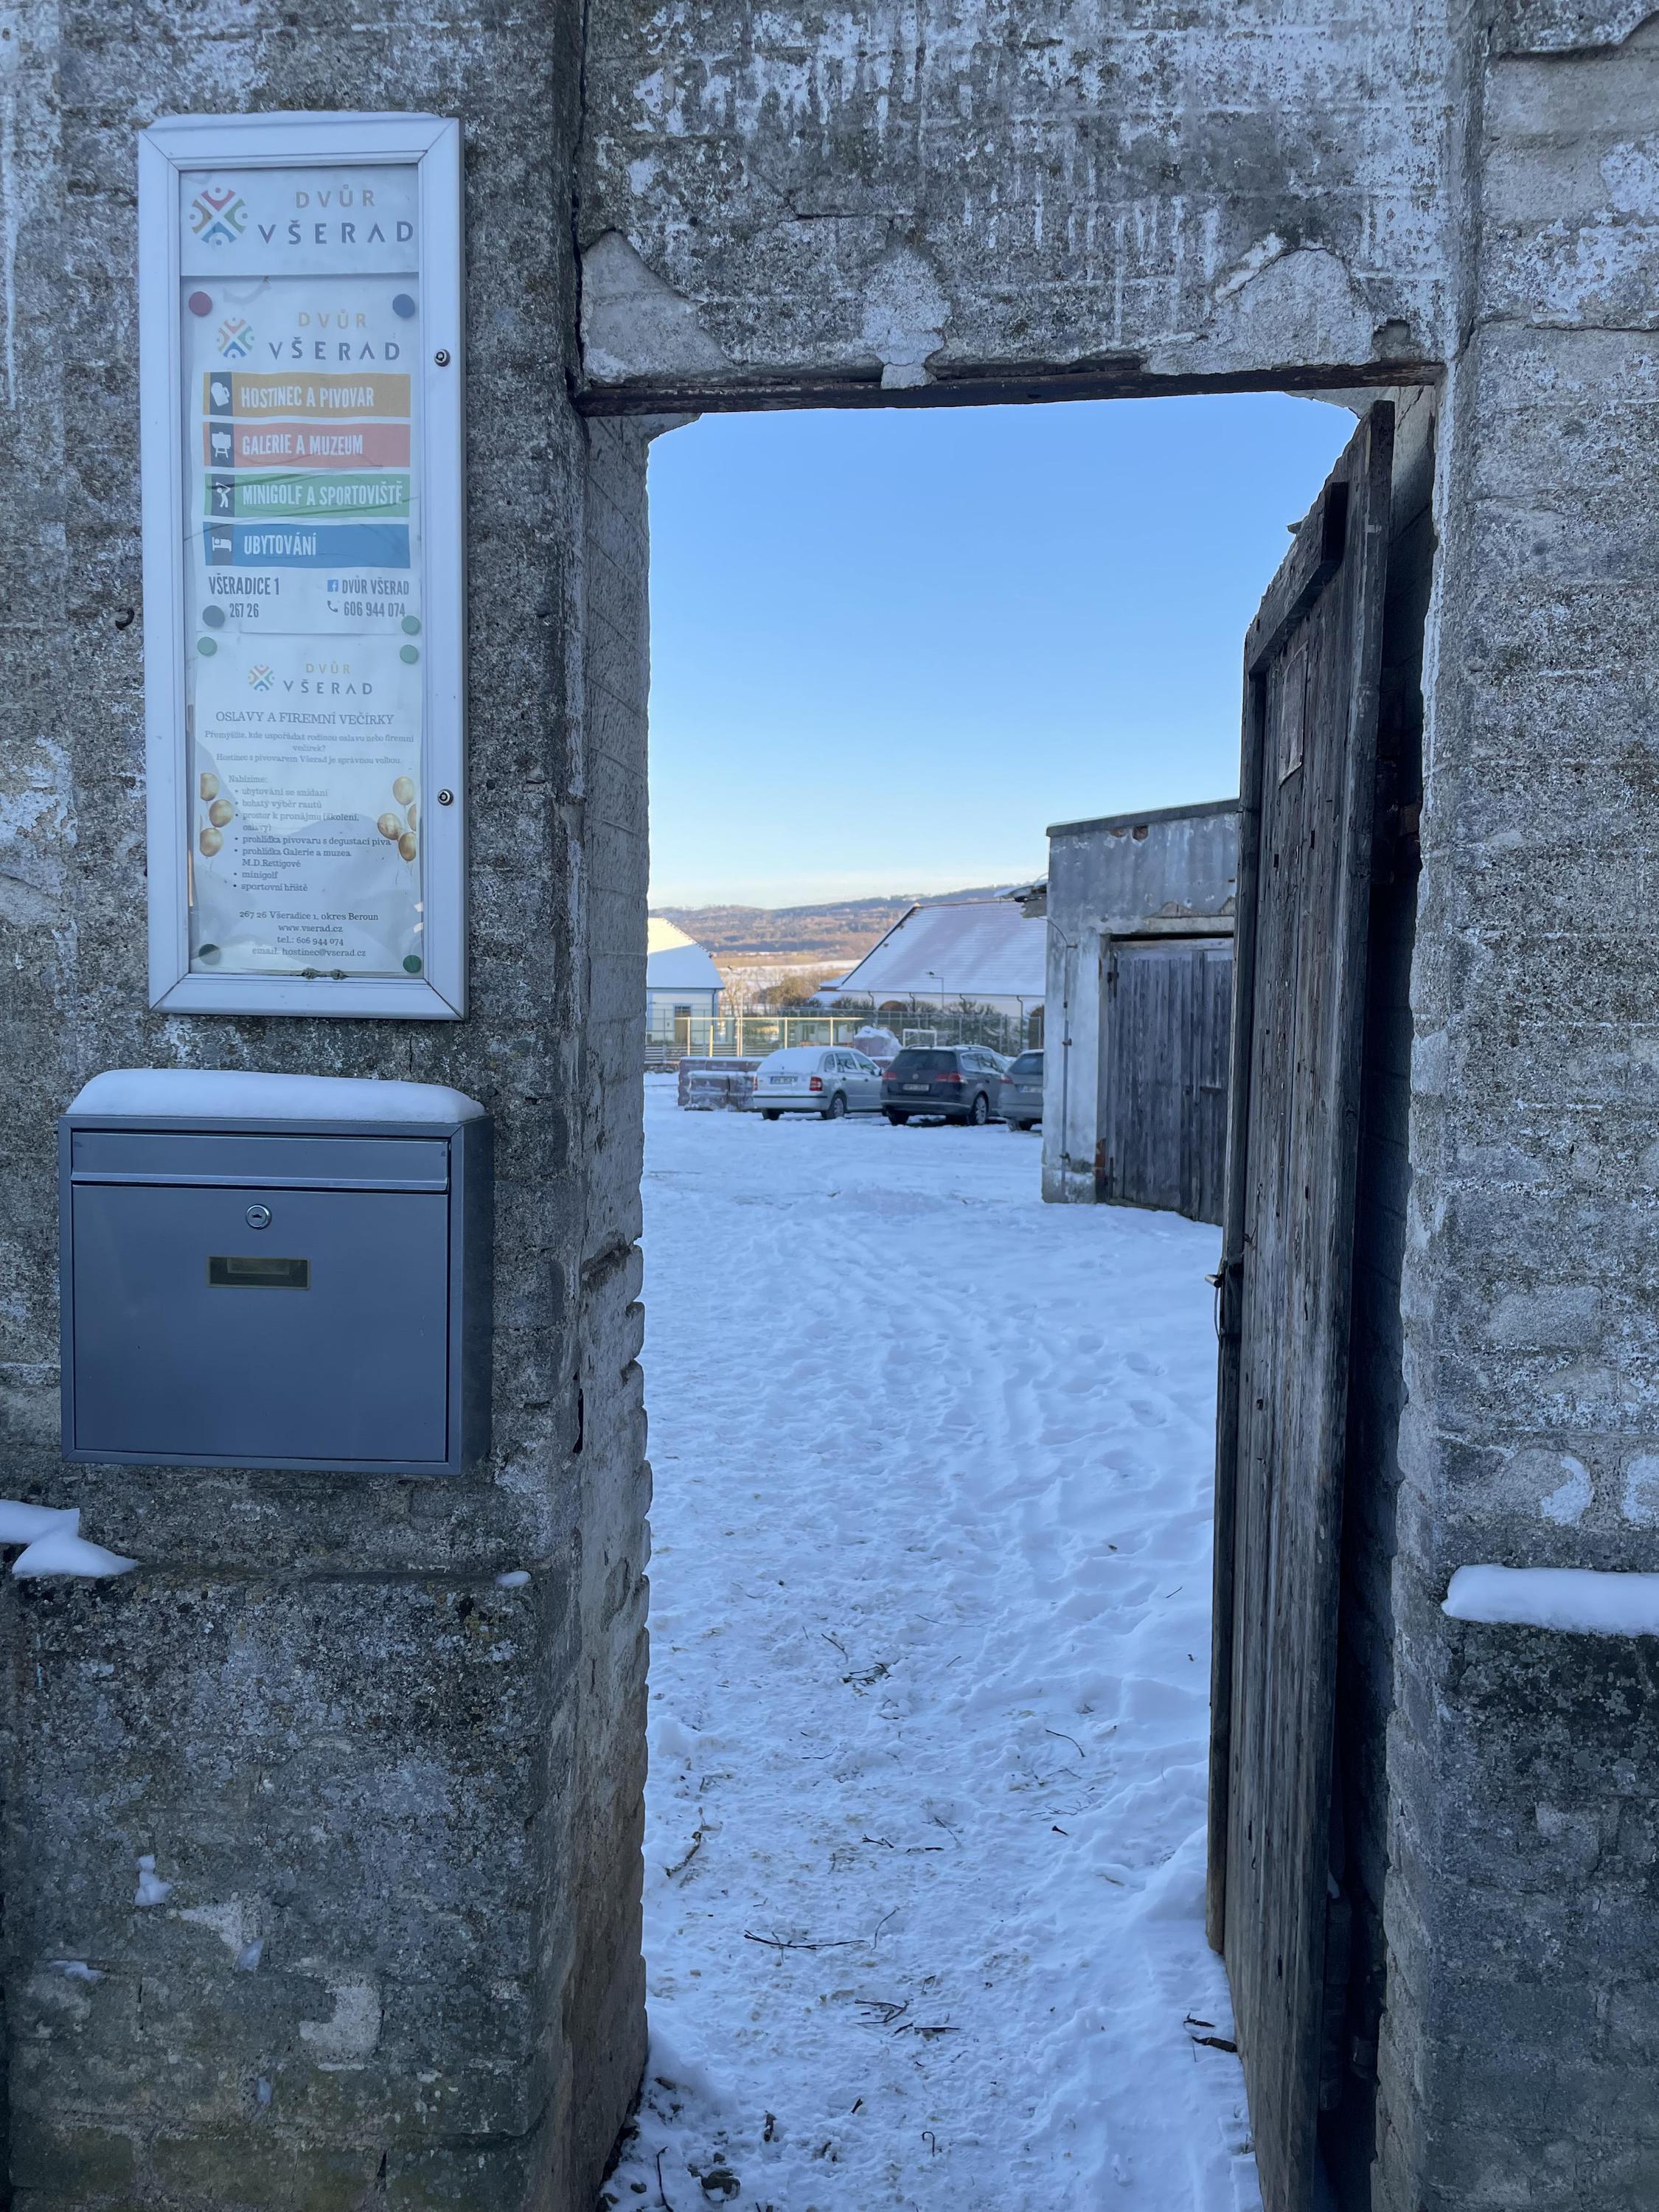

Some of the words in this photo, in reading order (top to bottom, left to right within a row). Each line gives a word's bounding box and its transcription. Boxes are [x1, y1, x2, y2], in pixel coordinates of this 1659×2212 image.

[296, 184, 375, 209] DVŮR
[258, 220, 414, 245] VŠERAD
[299, 309, 366, 329] DVŮR
[268, 337, 400, 361] VŠERAD
[241, 386, 302, 407] HOSTINEC
[307, 387, 316, 406] A
[320, 387, 374, 408] PIVOVAR
[243, 434, 291, 455] GALERIE
[296, 435, 306, 454] A
[310, 435, 363, 455] MUZEUM
[243, 484, 302, 506] MINIGOLF
[307, 485, 316, 506] A
[319, 481, 403, 506] SPORTOVIŠTĚ
[244, 532, 316, 555] UBYTOVÁNÍ
[209, 573, 271, 595] VŠERADICE
[274, 578, 279, 595] 1
[342, 575, 367, 594] DVŮR
[371, 577, 409, 595] VŠERAD
[229, 603, 244, 618] 267
[247, 603, 259, 618] 26
[344, 602, 363, 616] 606
[366, 602, 385, 617] 944
[388, 602, 406, 617] 074
[305, 661, 351, 674] DVŮR
[283, 679, 372, 695] VŠERAD
[215, 712, 264, 722] OSLAVY
[267, 712, 276, 722] A
[279, 712, 336, 724] FIREMNÍ
[339, 712, 394, 725] VEČÍRKY
[282, 836, 321, 845] pivovaru
[329, 837, 370, 846] degustací
[372, 838, 392, 847] piva
[283, 848, 314, 856] Galerie
[242, 871, 279, 880] minigolf
[241, 883, 282, 891] sportovní
[239, 911, 255, 919] 267
[348, 912, 378, 921] Beroun
[278, 925, 343, 933] www.vserad.cz
[313, 938, 327, 946] 944
[330, 938, 344, 946] 074
[282, 948, 366, 956] hostinec@vserad.cz
